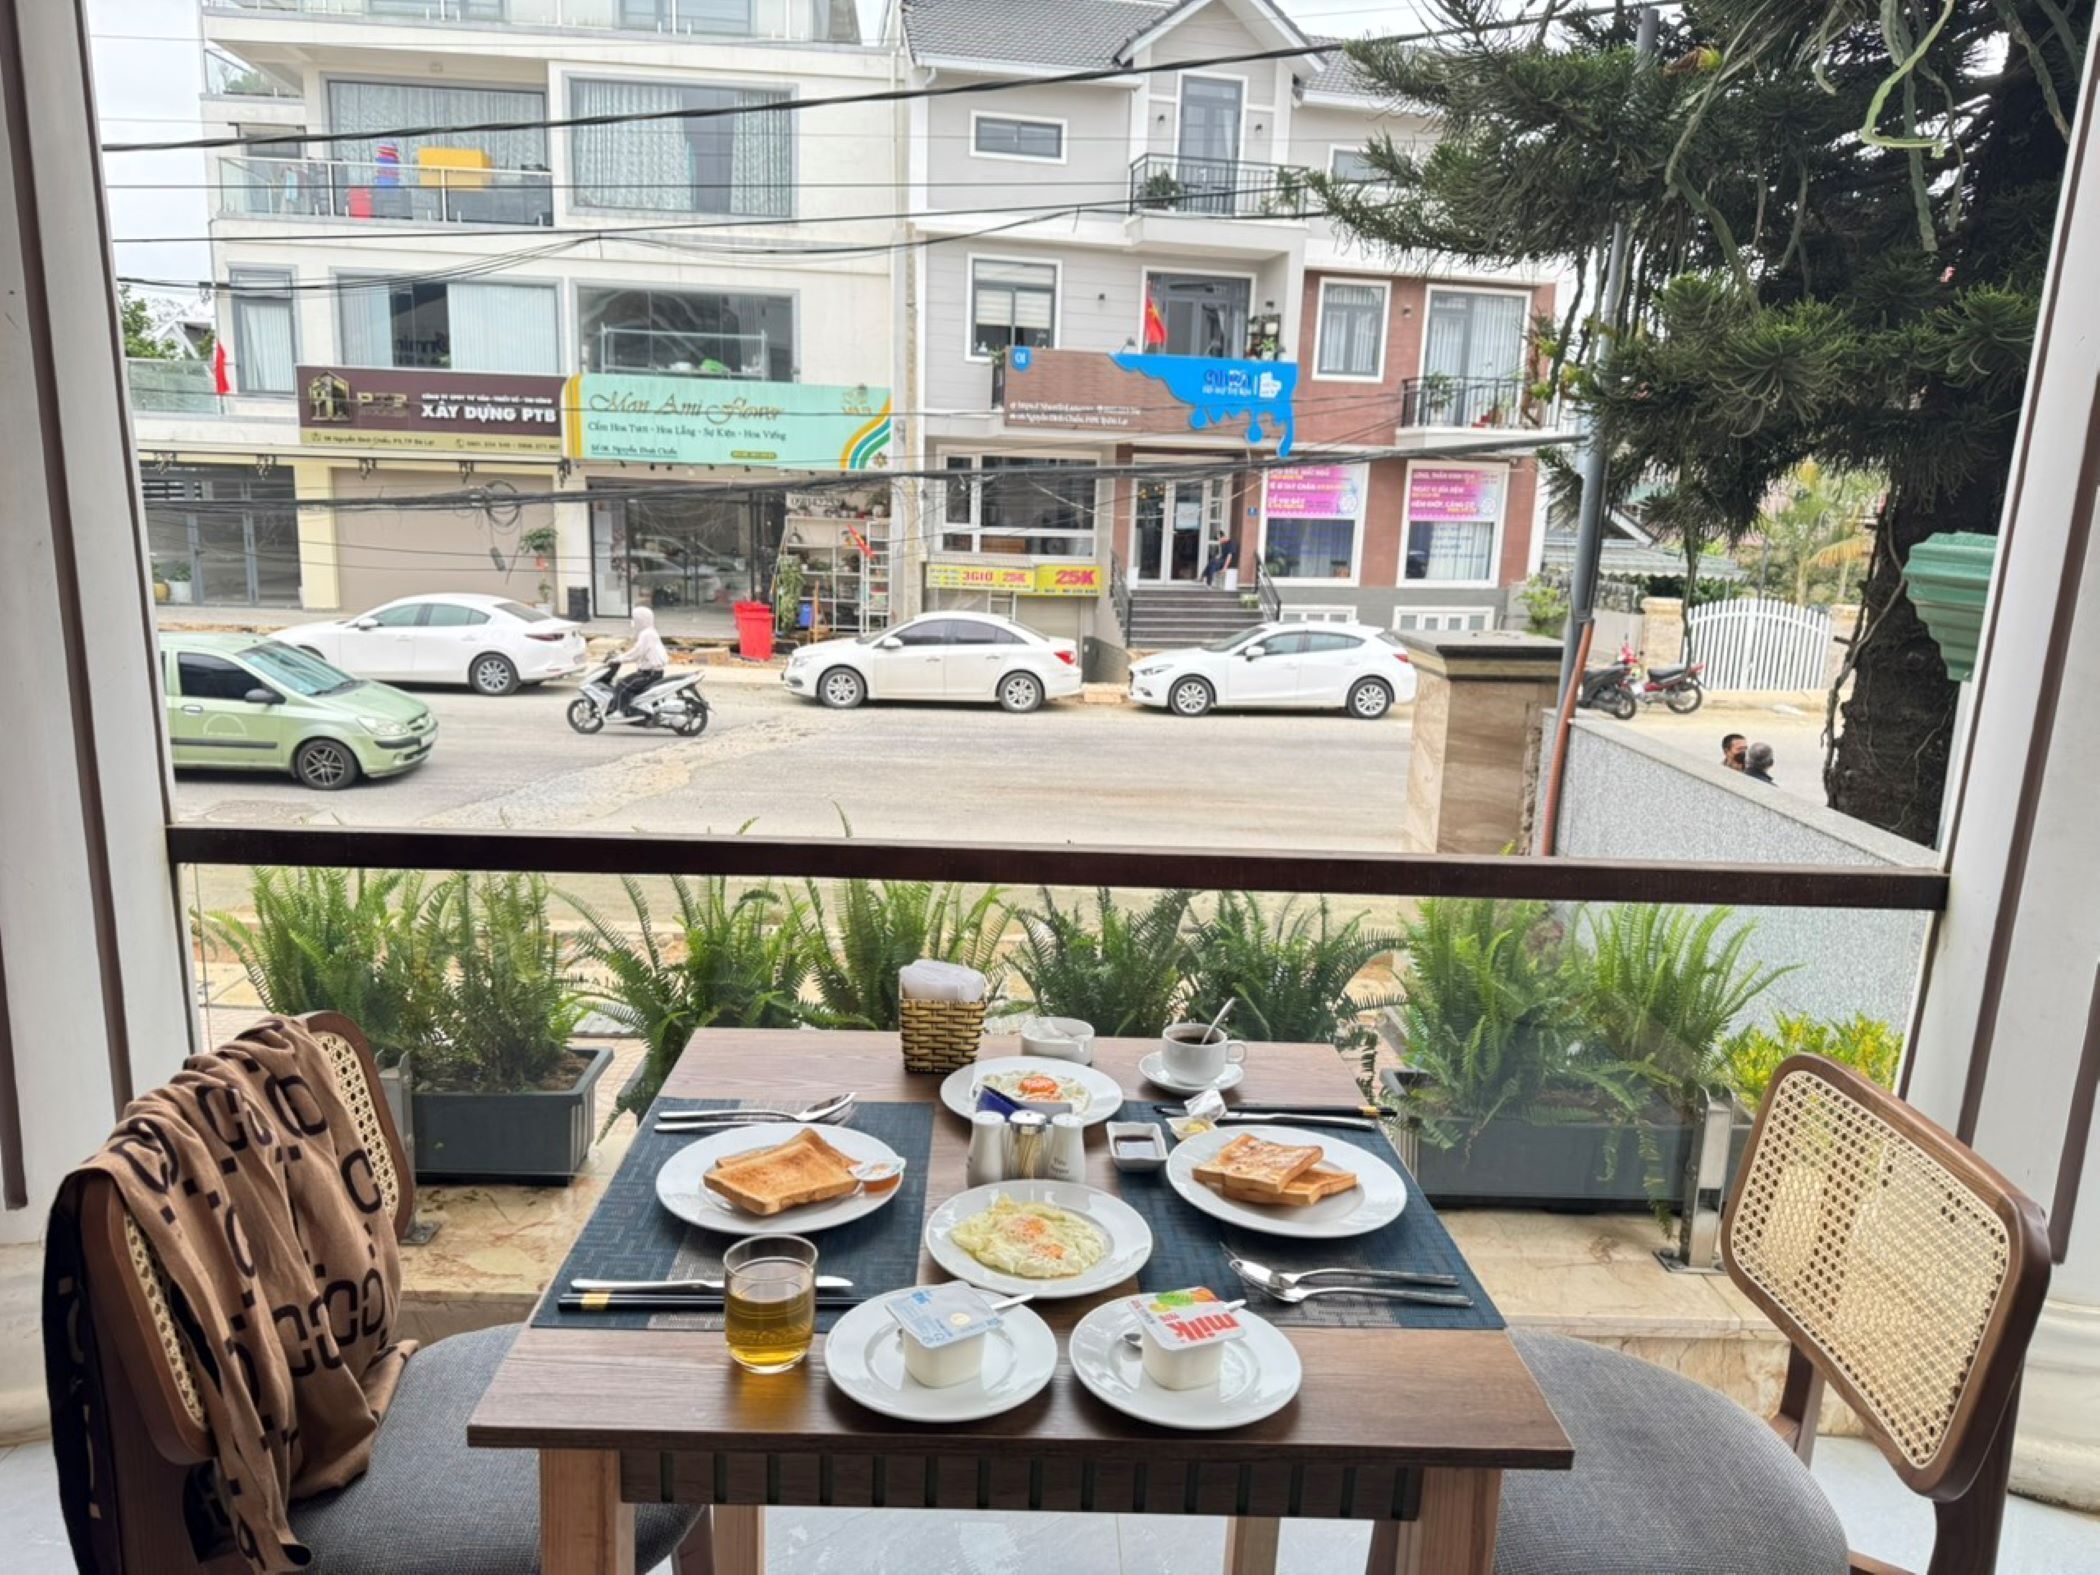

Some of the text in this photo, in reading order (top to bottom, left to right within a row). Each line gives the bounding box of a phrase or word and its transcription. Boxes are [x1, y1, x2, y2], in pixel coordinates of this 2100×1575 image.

[421, 400, 460, 419] XÂY
[464, 403, 517, 423] DỰNG
[521, 407, 556, 422] PTB
[655, 393, 703, 416] Ami
[610, 422, 627, 432] Hoa
[656, 425, 673, 435] Hoa
[744, 429, 761, 439] Hoa
[1055, 569, 1096, 586] 25K
[1166, 1312, 1241, 1342] milk
